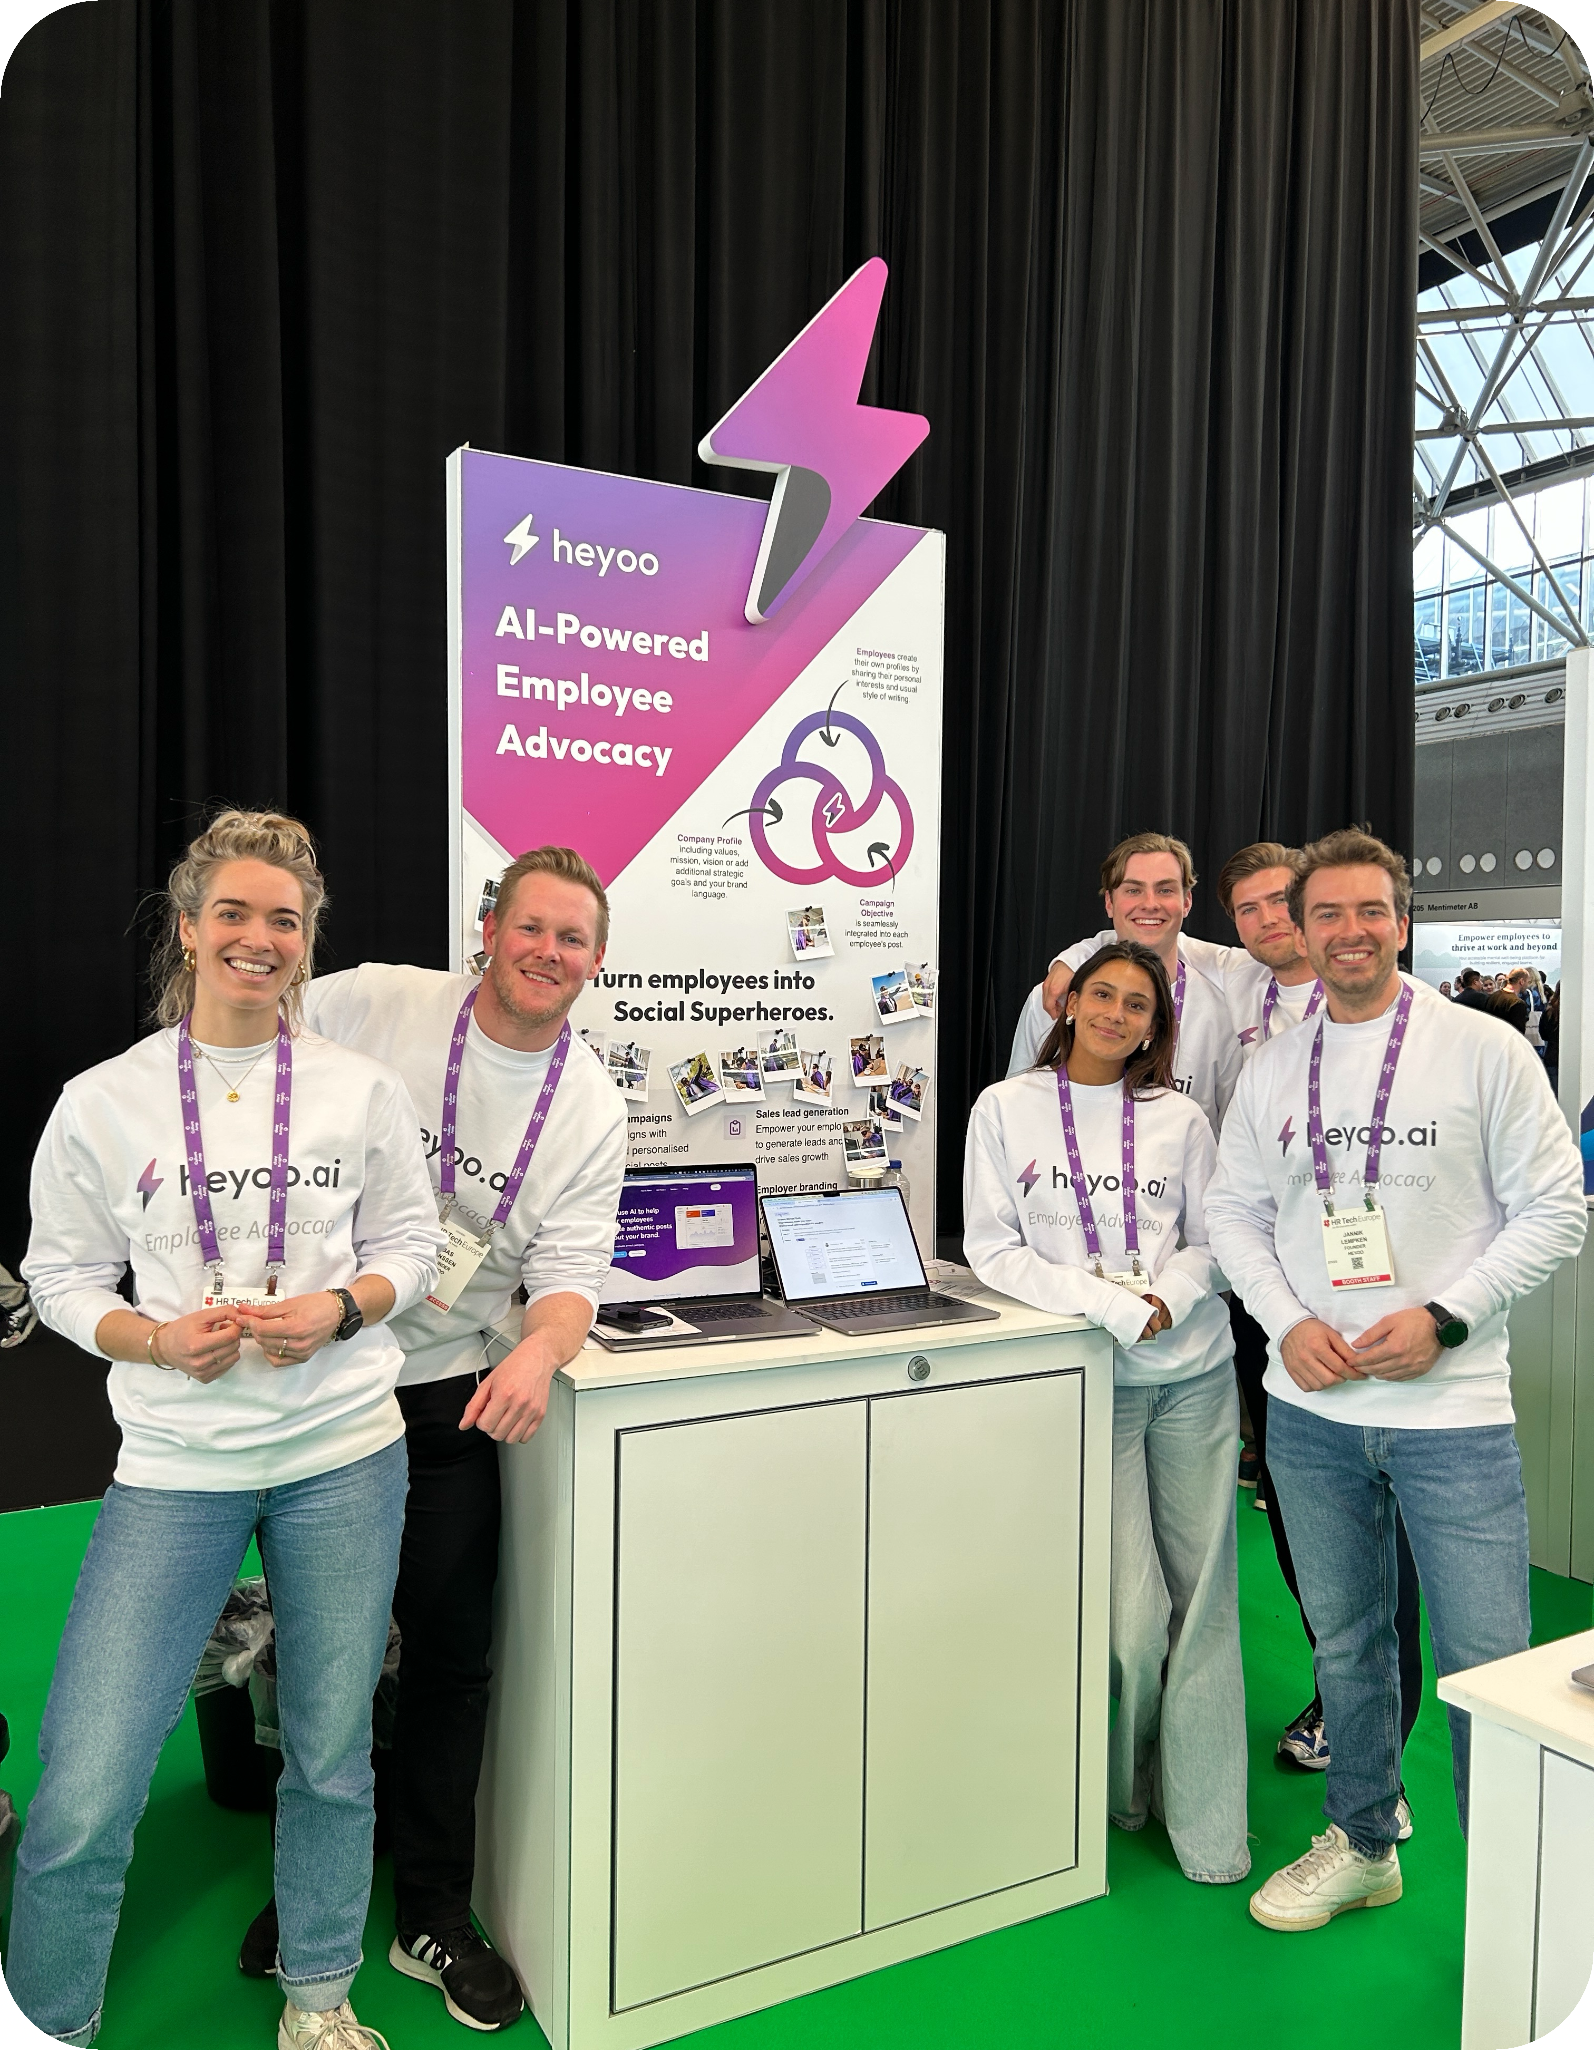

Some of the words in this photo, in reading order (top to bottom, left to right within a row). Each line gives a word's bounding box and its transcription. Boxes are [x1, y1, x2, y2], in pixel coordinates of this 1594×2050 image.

[552, 528, 660, 577] heyoo
[495, 605, 709, 662] AI-Powered
[856, 647, 896, 660] Employees
[897, 654, 918, 663] create
[854, 658, 869, 667] their
[870, 661, 885, 669] own
[886, 663, 910, 672] profiles
[911, 664, 920, 674] by
[851, 668, 877, 680] sharing
[877, 671, 892, 680] their
[893, 674, 922, 683] personal
[496, 664, 673, 717] Employee
[856, 679, 885, 690] interests
[885, 683, 899, 691] and
[899, 685, 918, 693] usual
[862, 691, 878, 701] style
[879, 692, 887, 700] of
[496, 723, 673, 777] Advocacy
[677, 833, 715, 846] Company
[717, 836, 743, 845] Profile
[679, 844, 713, 856] including
[714, 847, 740, 857] values,
[670, 855, 701, 866] mission,
[702, 857, 724, 866] vision
[725, 859, 734, 867] or
[734, 859, 749, 867] add
[675, 867, 712, 876] additional
[712, 869, 744, 880] strategic
[670, 878, 692, 887] goals
[693, 878, 708, 887] and
[708, 880, 726, 889] your
[726, 880, 748, 889] brand
[691, 889, 728, 900] language.
[859, 898, 895, 909] Campaign
[1427, 903, 1467, 912] Mentimeter
[1467, 902, 1479, 910] AB
[860, 908, 894, 918] Objective
[855, 919, 862, 927] is
[862, 920, 899, 930] seamlessly
[844, 929, 878, 939] integrated
[879, 930, 892, 938] into
[892, 930, 909, 938] each
[1458, 934, 1494, 942] Empower
[1496, 933, 1540, 942] employees
[849, 940, 887, 949] employee's
[887, 941, 904, 950] post.
[1451, 944, 1476, 952] thrive
[1487, 943, 1508, 951] work
[1509, 942, 1525, 951] and
[1526, 942, 1558, 953] beyond
[593, 967, 643, 989] Turn
[647, 968, 769, 995] employees
[773, 970, 816, 990] into
[613, 1000, 685, 1022] Social
[690, 1000, 835, 1027] Superheroes.
[627, 1113, 673, 1125] mpaigns
[755, 1109, 780, 1119] Sales
[782, 1108, 801, 1118] lead
[803, 1107, 849, 1119] generation
[648, 1128, 667, 1138] with
[755, 1124, 795, 1135] Empower
[796, 1124, 816, 1134] your
[816, 1122, 842, 1132] emplo
[755, 1140, 764, 1149] to
[765, 1139, 803, 1150] generate
[804, 1137, 826, 1147] leads
[631, 1143, 689, 1157] personalised
[755, 1155, 776, 1164] drive
[777, 1153, 800, 1163] sales
[801, 1152, 829, 1164] growth
[757, 1184, 798, 1195] Employer
[799, 1181, 838, 1192] branding
[1052, 1165, 1168, 1199] hyo.ai
[645, 1207, 660, 1215] help
[620, 1216, 654, 1224] employees
[1028, 1211, 1083, 1230] Employe
[1331, 1218, 1342, 1226] HR
[1342, 1216, 1358, 1224] Tech
[1358, 1213, 1381, 1222] Europe
[655, 1223, 673, 1231] posts
[144, 1225, 241, 1255] Emploee
[625, 1233, 640, 1241] your
[448, 1231, 463, 1246] Tech
[461, 1241, 484, 1258] Europe
[1362, 1275, 1381, 1283] STAFF
[215, 1297, 229, 1306] HR
